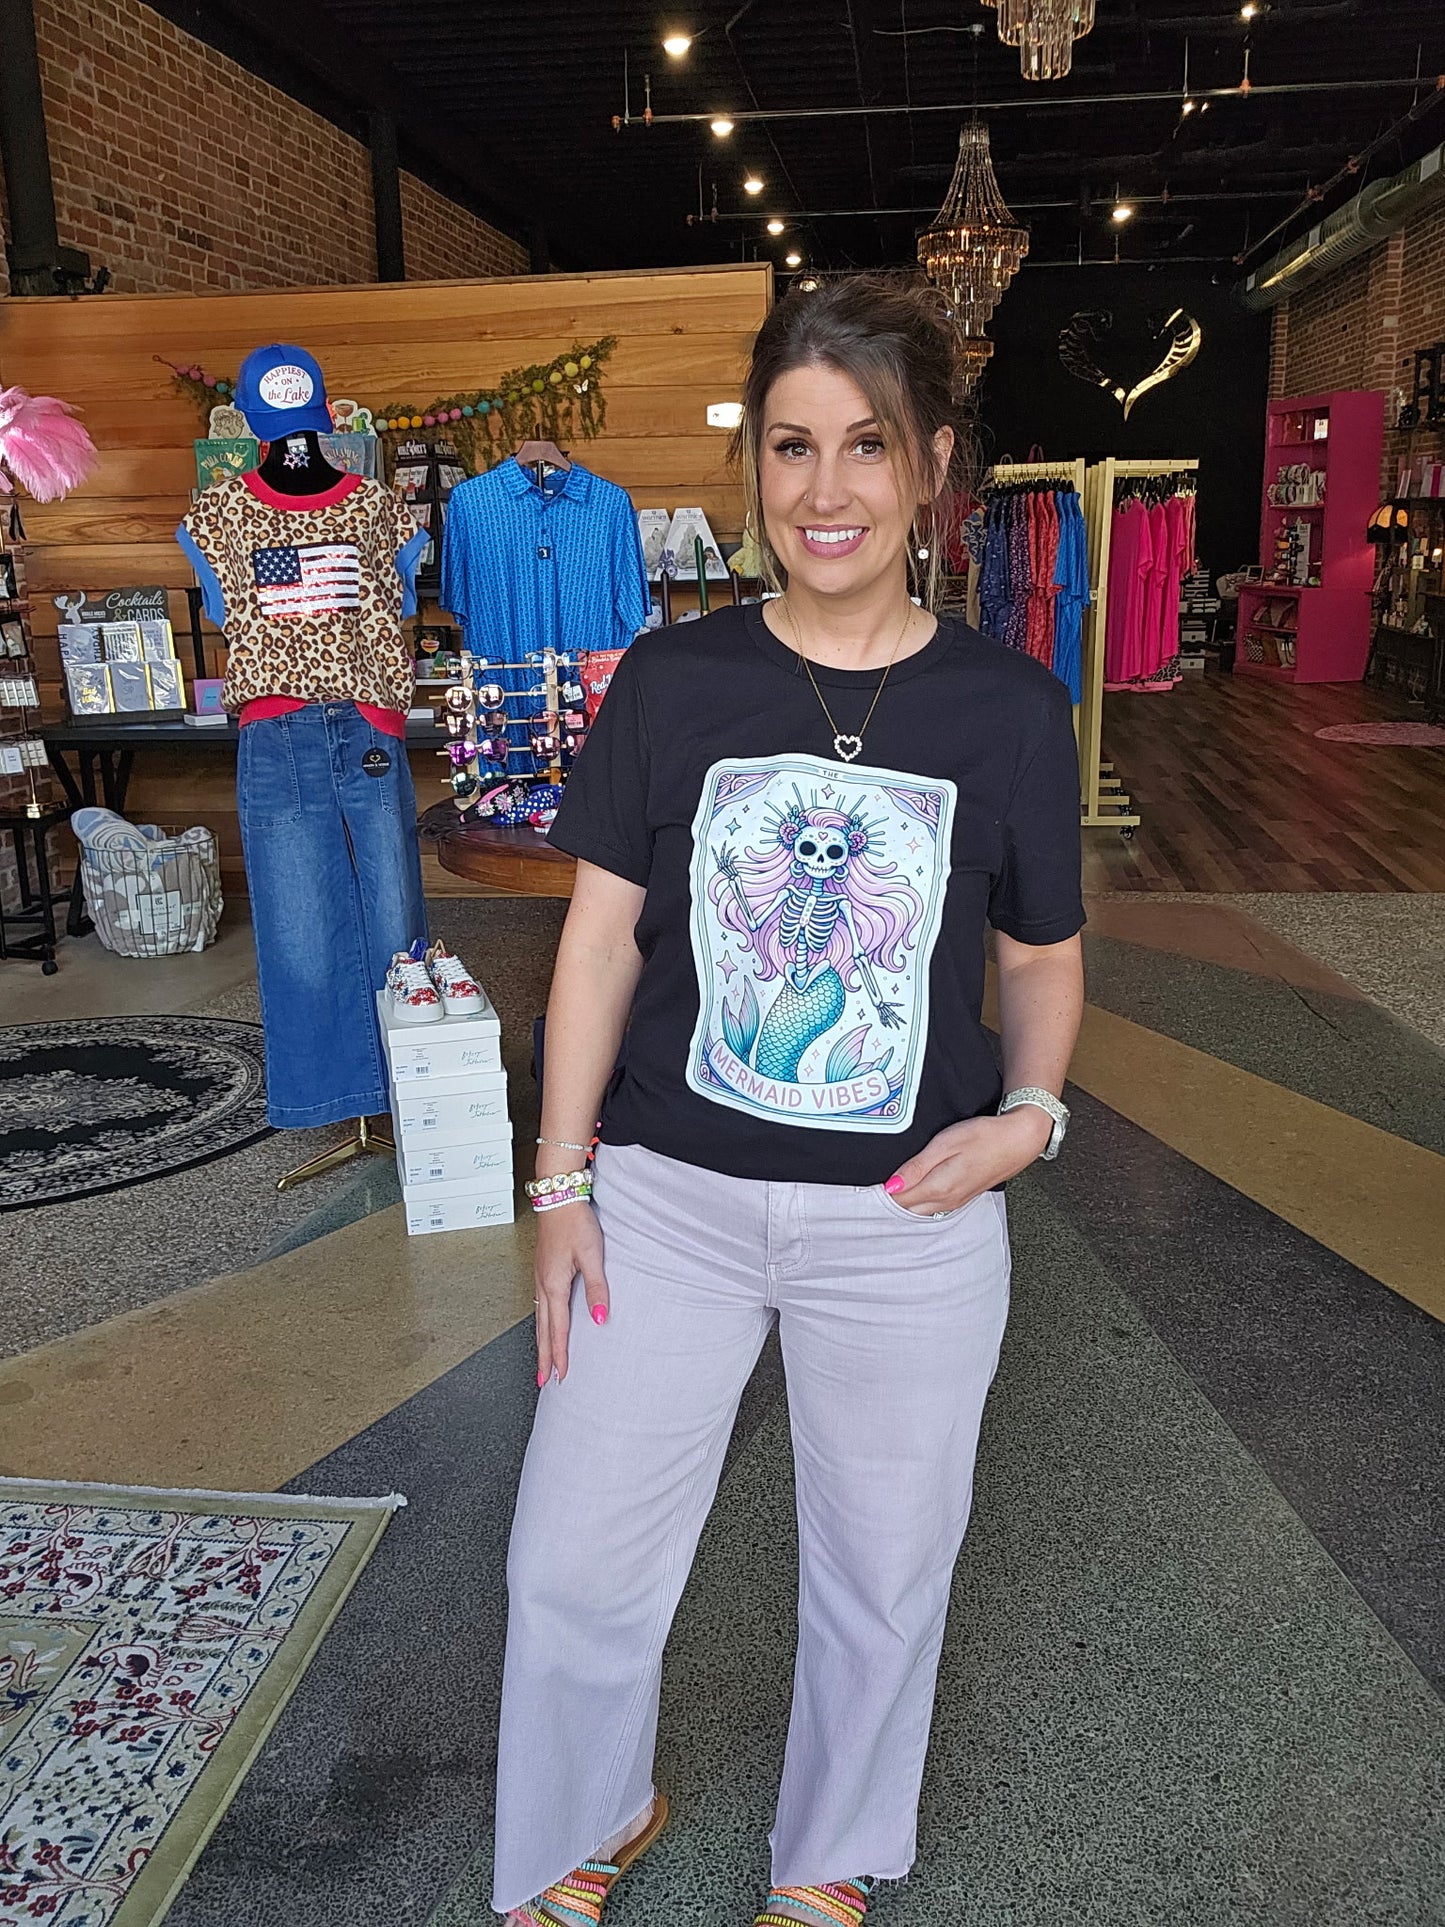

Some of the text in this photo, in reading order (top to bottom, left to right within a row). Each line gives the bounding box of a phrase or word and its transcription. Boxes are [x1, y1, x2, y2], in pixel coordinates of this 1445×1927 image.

[264, 366, 307, 384] HAPPIEST
[280, 377, 293, 386] ON
[268, 386, 310, 404] the Lake
[106, 590, 165, 609] Cocktails
[112, 607, 166, 622] & CARDS
[823, 770, 839, 779] THE
[713, 1045, 883, 1110] MERMAID VIBES
